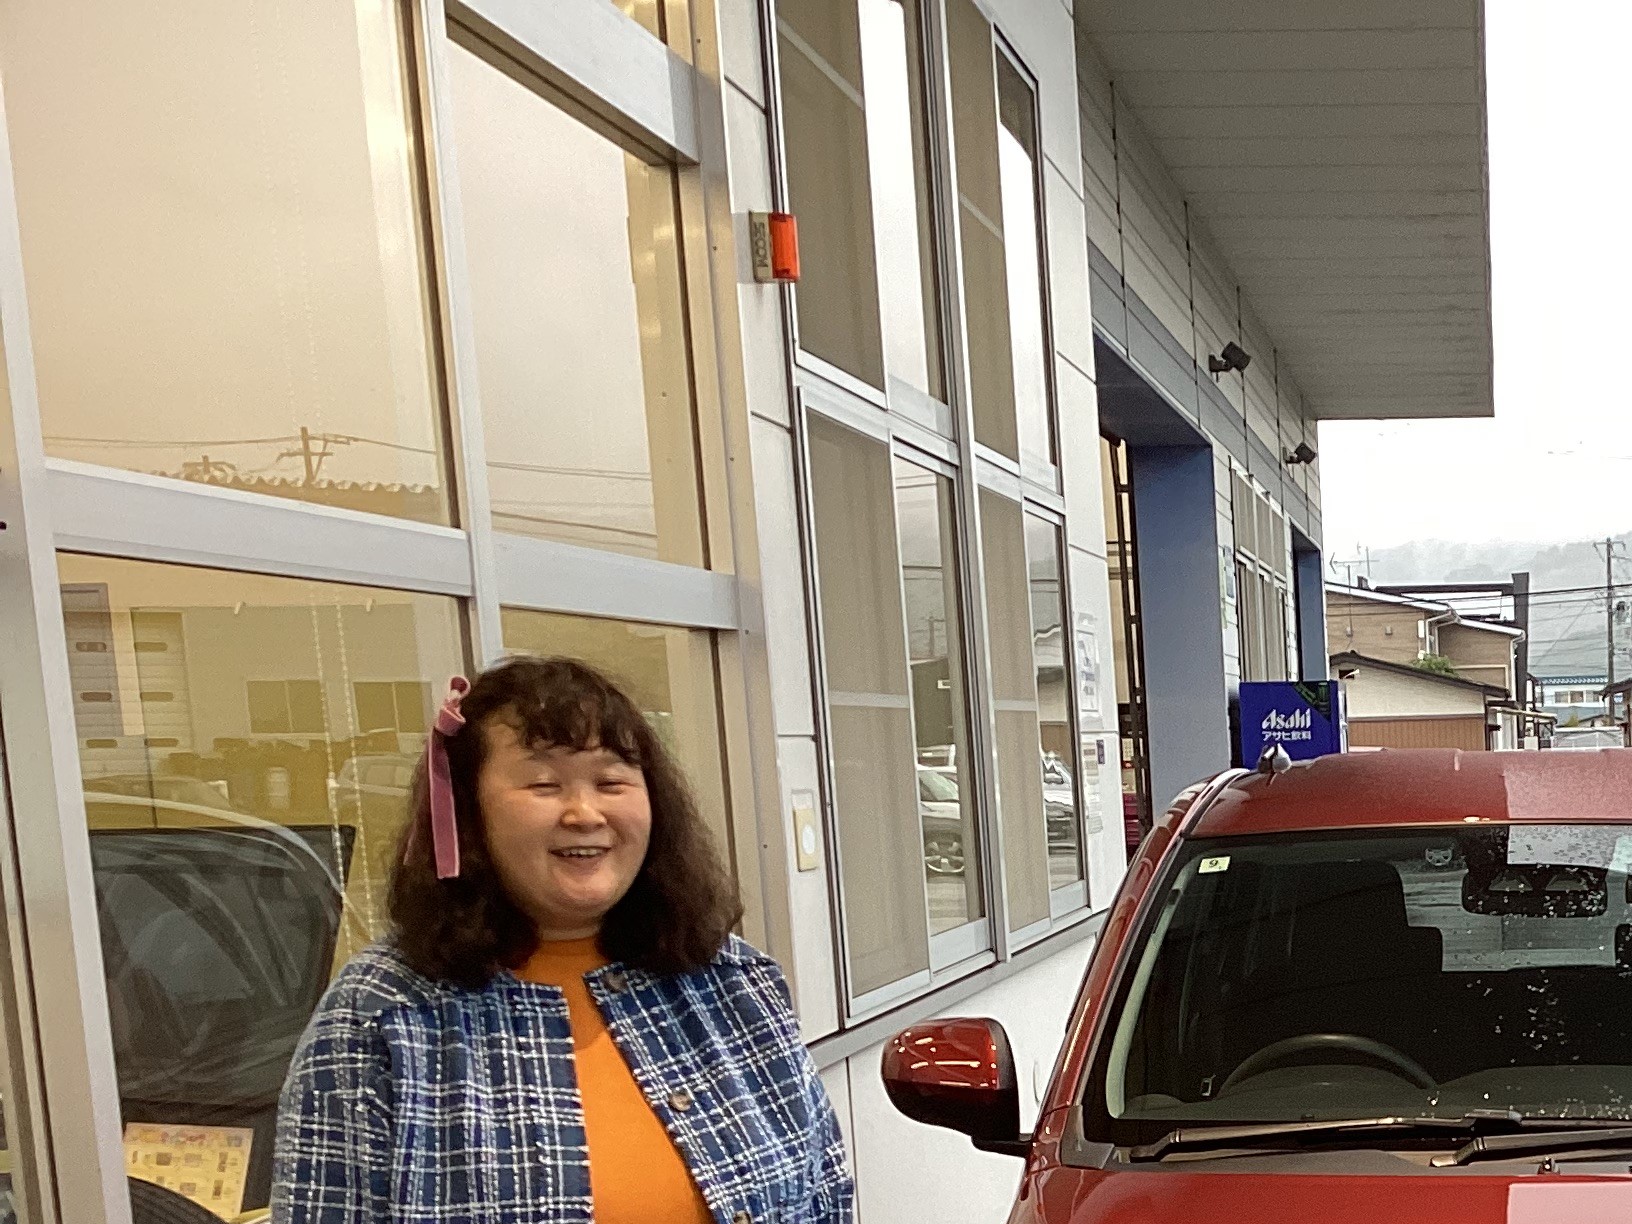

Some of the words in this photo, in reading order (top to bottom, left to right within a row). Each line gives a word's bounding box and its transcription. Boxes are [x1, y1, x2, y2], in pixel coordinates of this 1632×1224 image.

[1261, 708, 1311, 729] Asahi
[1261, 730, 1311, 741] アサヒ飲料
